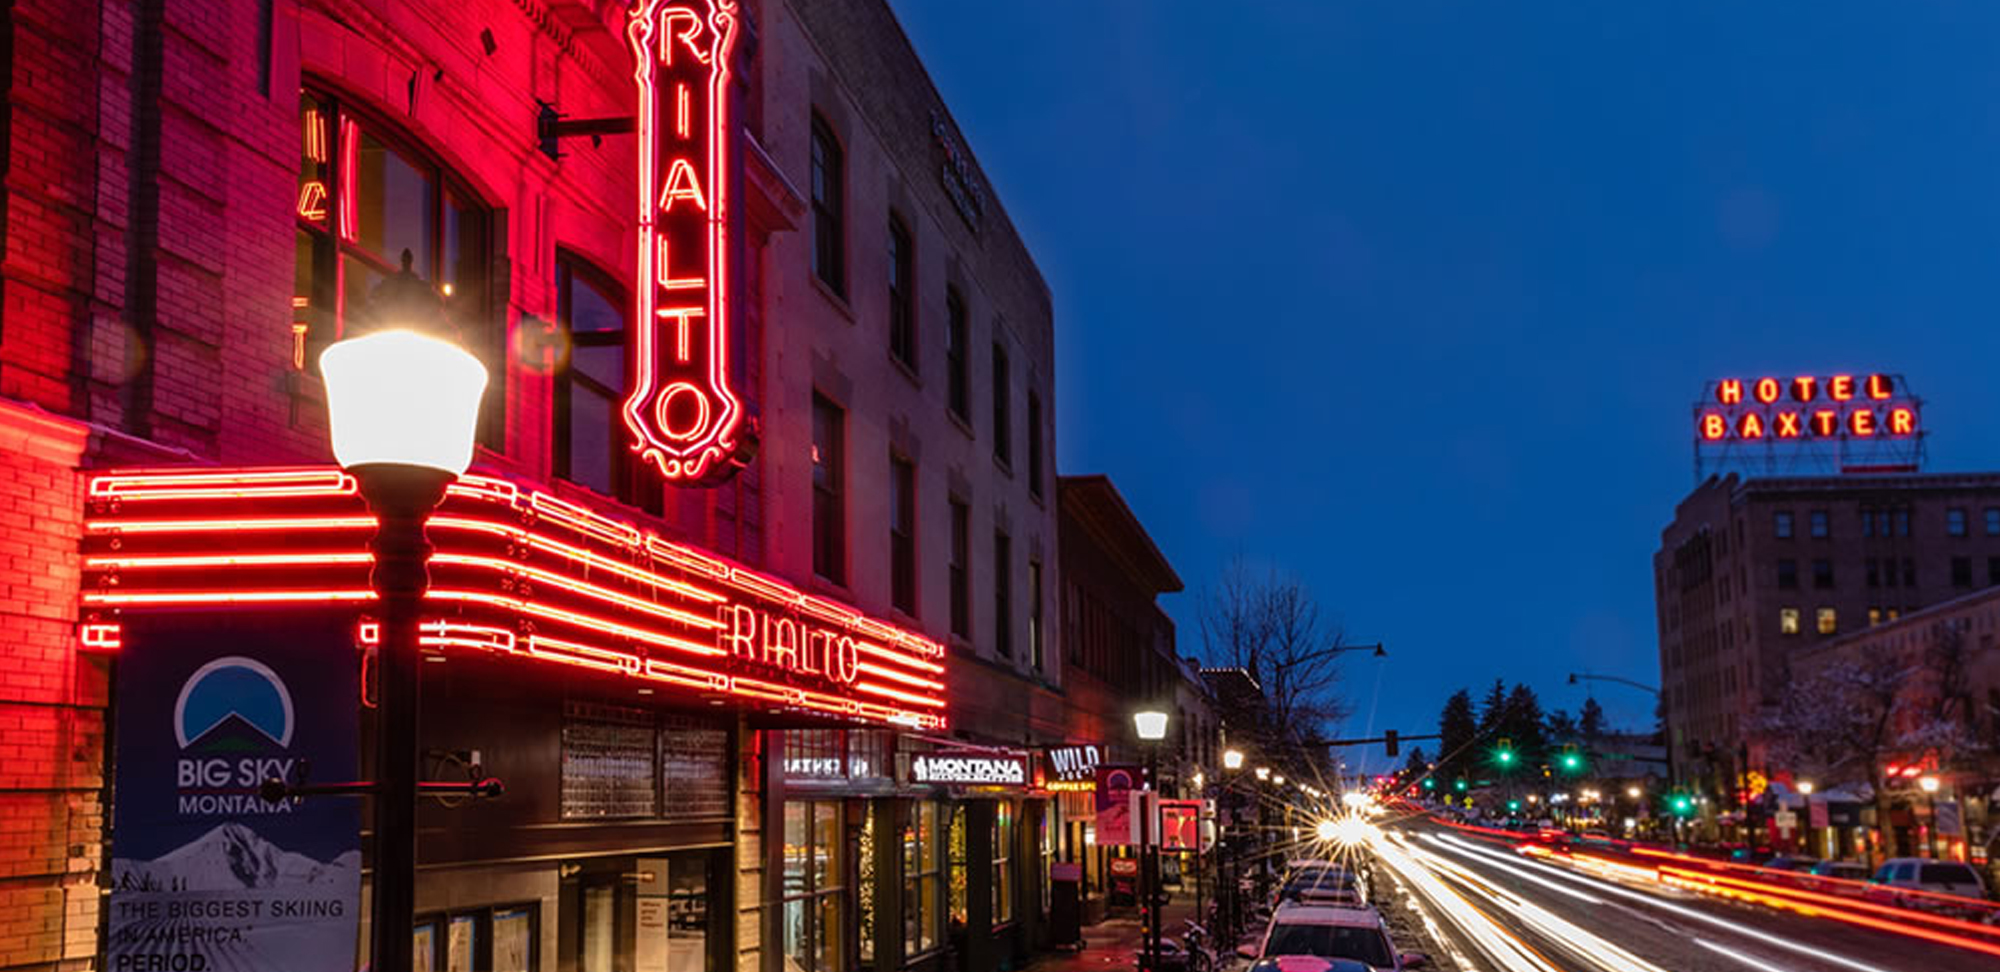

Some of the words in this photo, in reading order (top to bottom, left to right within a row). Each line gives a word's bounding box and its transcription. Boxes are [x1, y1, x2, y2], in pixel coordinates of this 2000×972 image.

[656, 6, 711, 442] RIALTO
[1720, 374, 1891, 404] HOTEL
[1704, 409, 1912, 440] BAXTER
[733, 604, 857, 683] RIALTO
[178, 759, 231, 787] BIG
[238, 759, 294, 787] SKY
[928, 758, 1024, 775] MONTANA
[1050, 745, 1100, 773] WILD
[179, 795, 292, 814] MONTANA
[118, 901, 159, 918] THE
[169, 900, 264, 918] BIGGEST
[271, 900, 343, 917] SKIING
[118, 928, 138, 944] IN
[116, 954, 211, 972] PERIOD.
